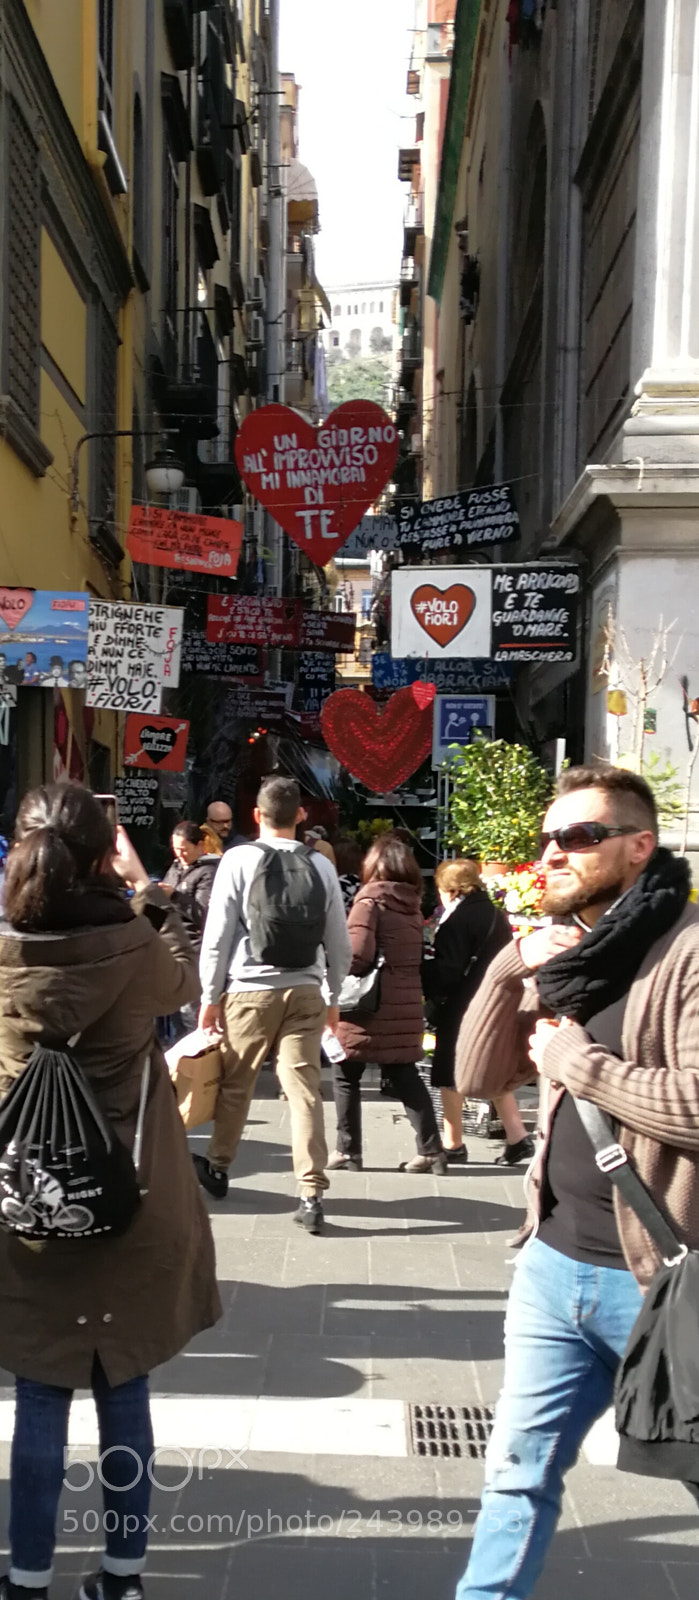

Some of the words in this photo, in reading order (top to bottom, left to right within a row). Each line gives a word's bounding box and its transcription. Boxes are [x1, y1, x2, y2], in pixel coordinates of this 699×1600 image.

[274, 433, 297, 451] UN
[244, 448, 267, 472] ALL'
[274, 444, 378, 470] IMPROVVISO
[261, 472, 280, 490] MI
[286, 467, 366, 488] INNAMORAI
[468, 486, 510, 504] FUSSE
[295, 509, 339, 539] TE
[494, 574, 514, 593] ME
[416, 598, 458, 614] #VOLO
[504, 593, 518, 609] E
[524, 592, 544, 608] TE
[67, 1186, 103, 1200] NIGHT
